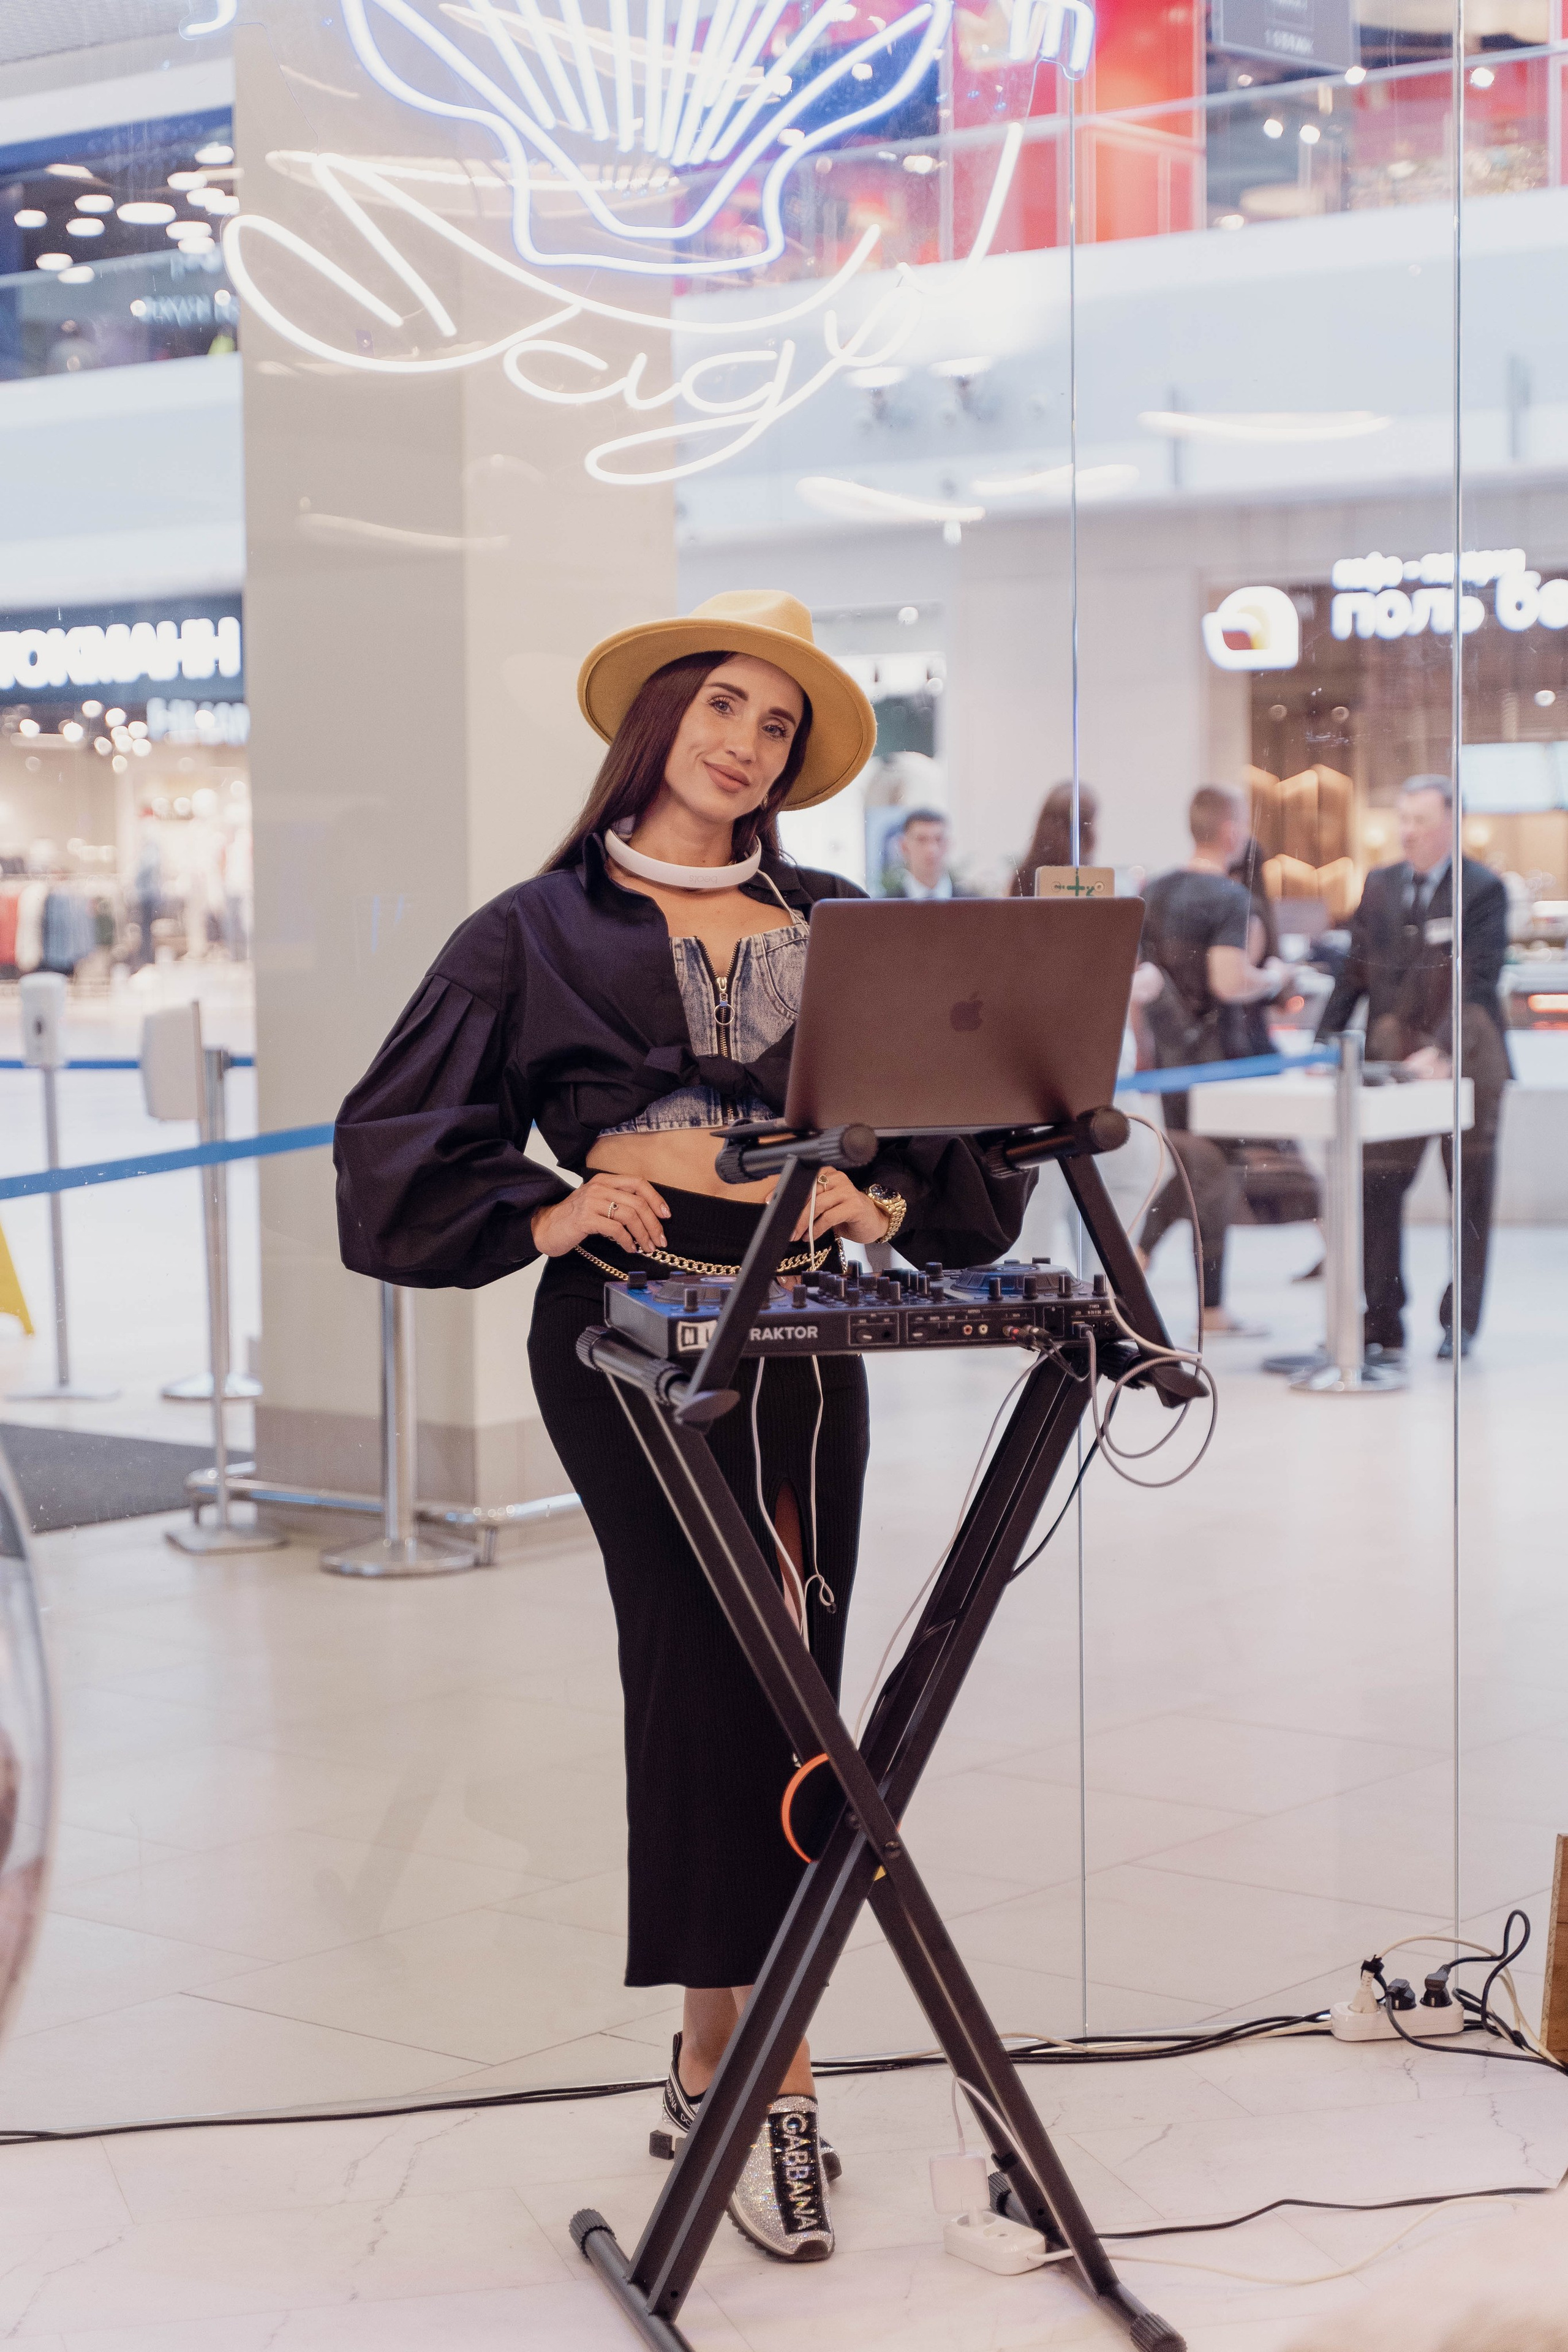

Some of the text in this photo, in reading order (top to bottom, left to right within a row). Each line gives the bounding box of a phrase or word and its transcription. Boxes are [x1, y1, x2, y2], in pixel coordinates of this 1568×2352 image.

[750, 1325, 818, 1341] RAKTOR
[680, 2113, 692, 2127] DO
[782, 2113, 818, 2231] GABBANA
